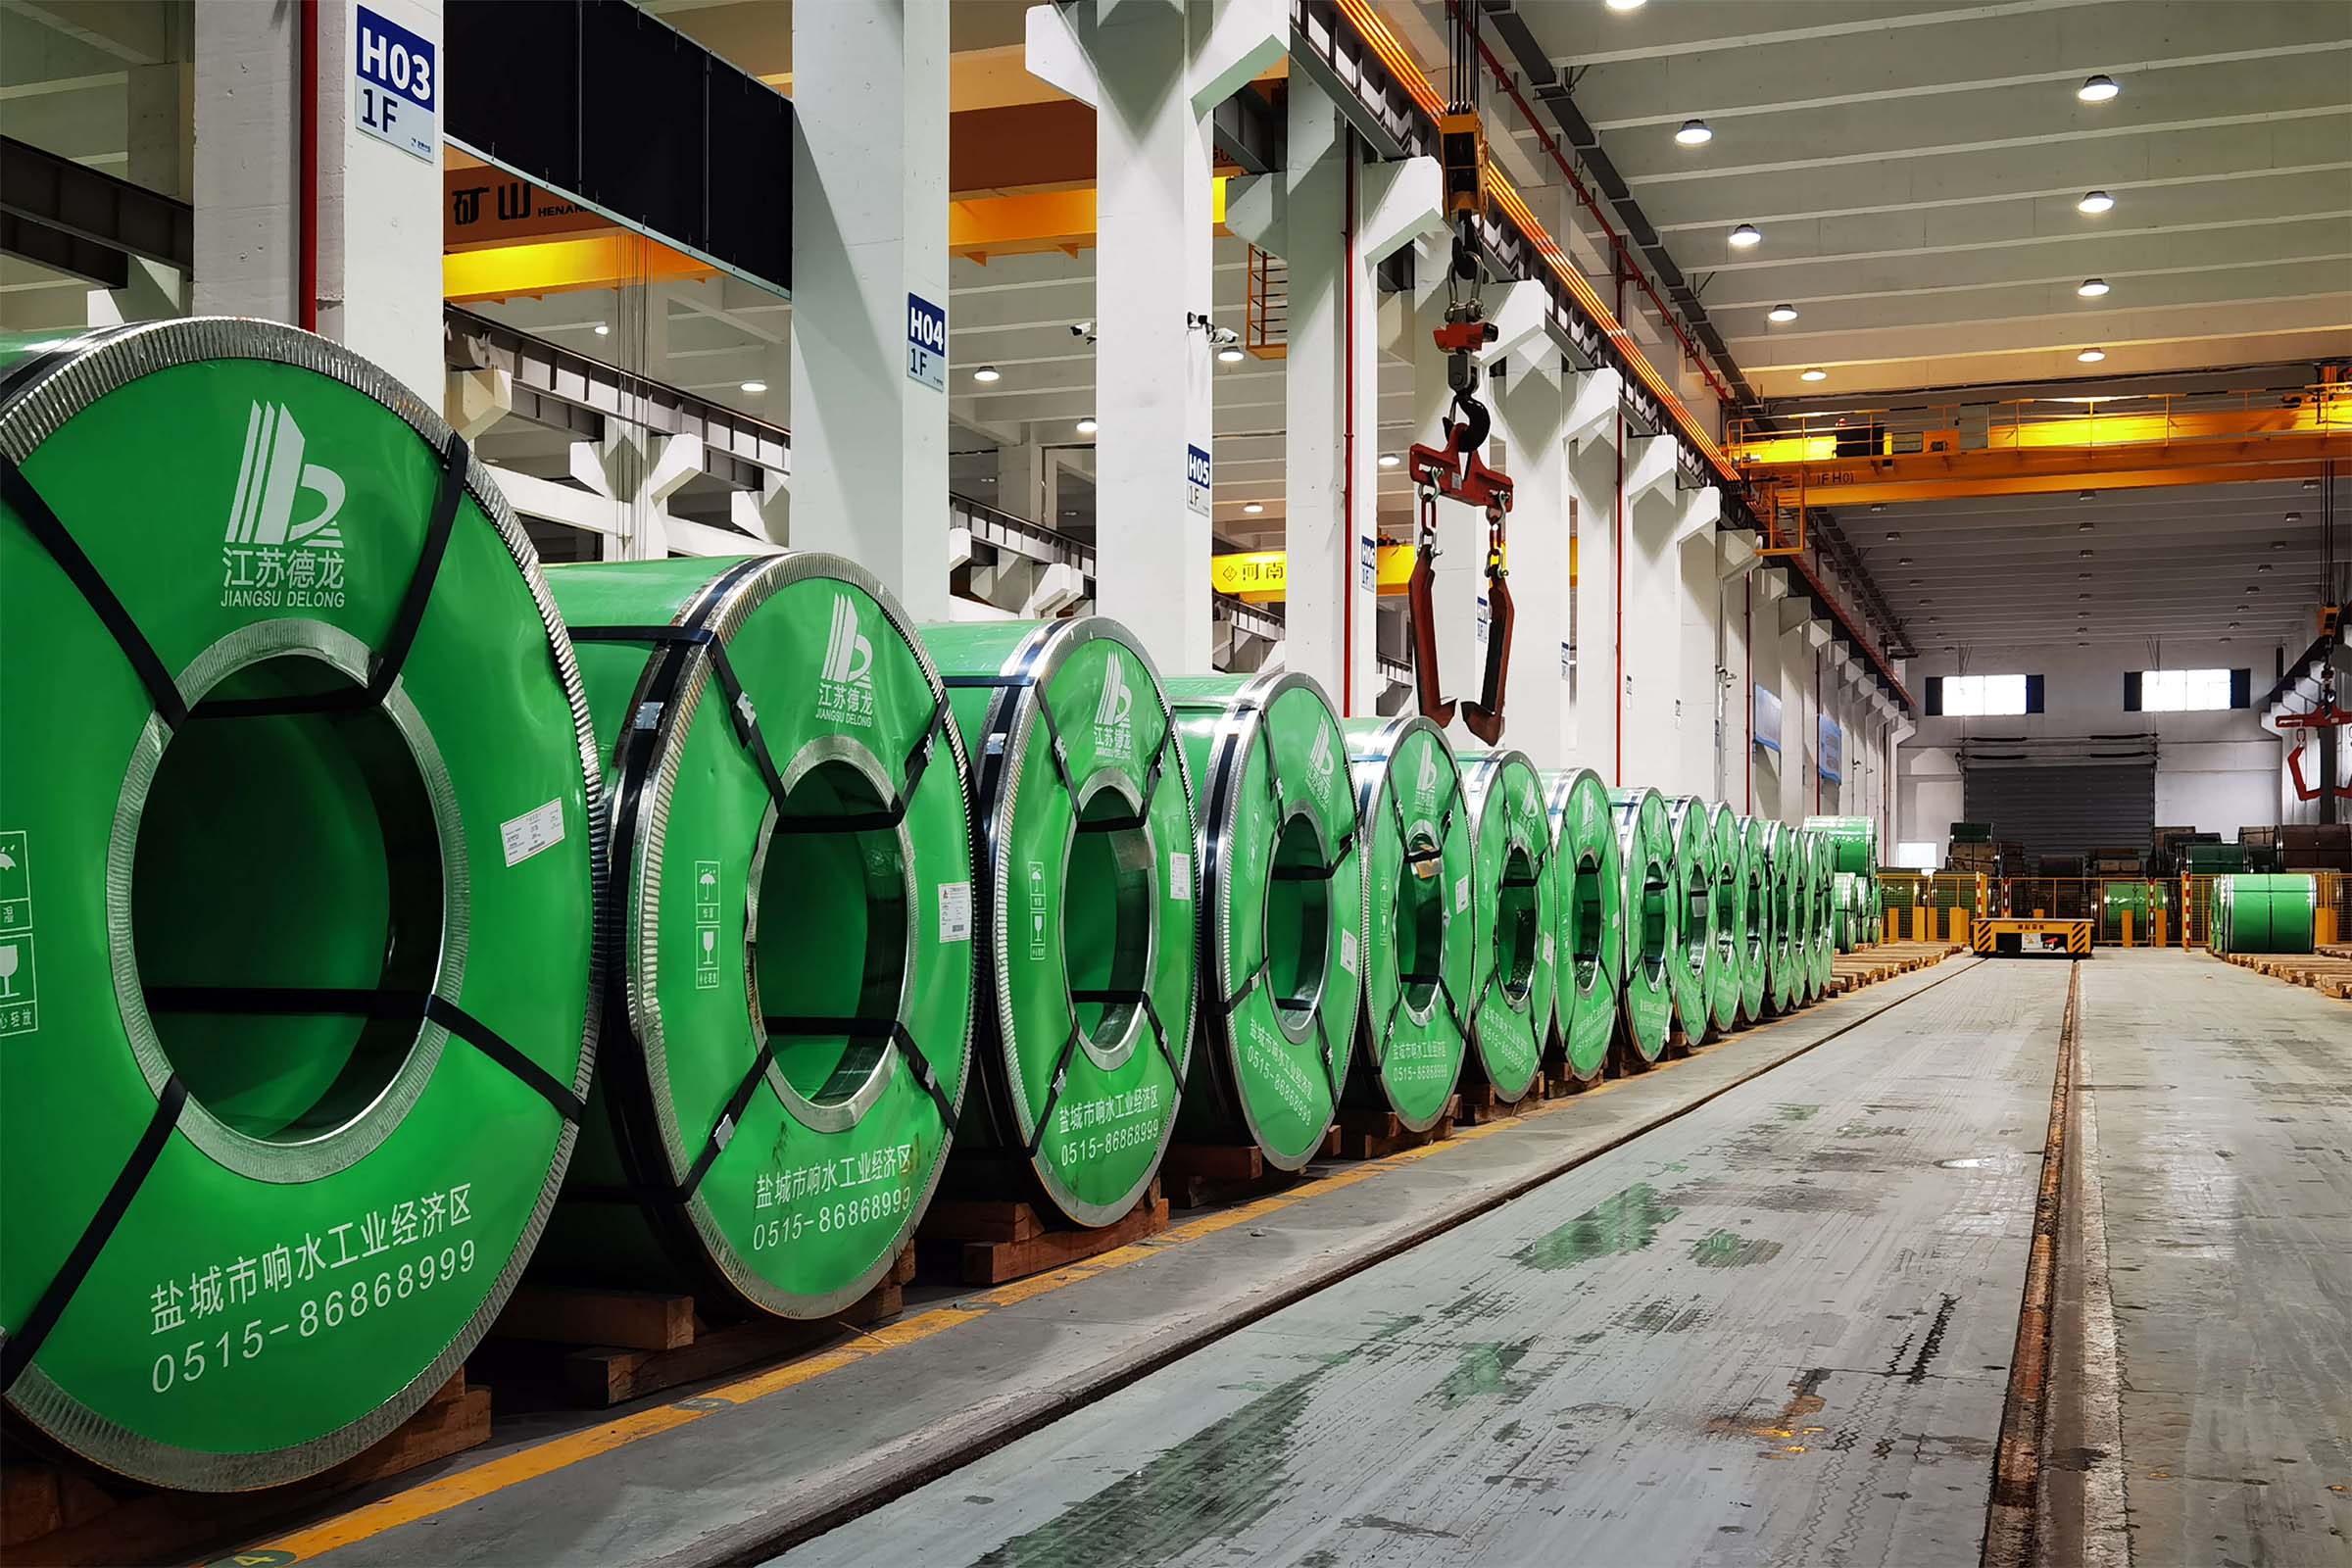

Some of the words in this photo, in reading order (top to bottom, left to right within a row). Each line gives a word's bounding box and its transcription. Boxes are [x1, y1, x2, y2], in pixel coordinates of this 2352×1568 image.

[362, 26, 431, 101] H03
[362, 88, 398, 133] 1F
[910, 307, 943, 351] H04
[910, 348, 927, 376] 1F
[1189, 453, 1209, 485] H05
[221, 547, 345, 588] 江苏德龙
[220, 590, 282, 608] JIANGSU
[286, 591, 345, 609] DELONG
[818, 682, 873, 715] 江苏德龙
[846, 712, 872, 727] DELONG
[1061, 1119, 1158, 1166] 0515-86868999
[756, 1144, 911, 1208] 盐城市响水工业经济区
[754, 1187, 910, 1250] 0515-86868999
[151, 1183, 472, 1335] 盐城市响水工业经济区
[152, 1240, 475, 1393] 0515-86868999
